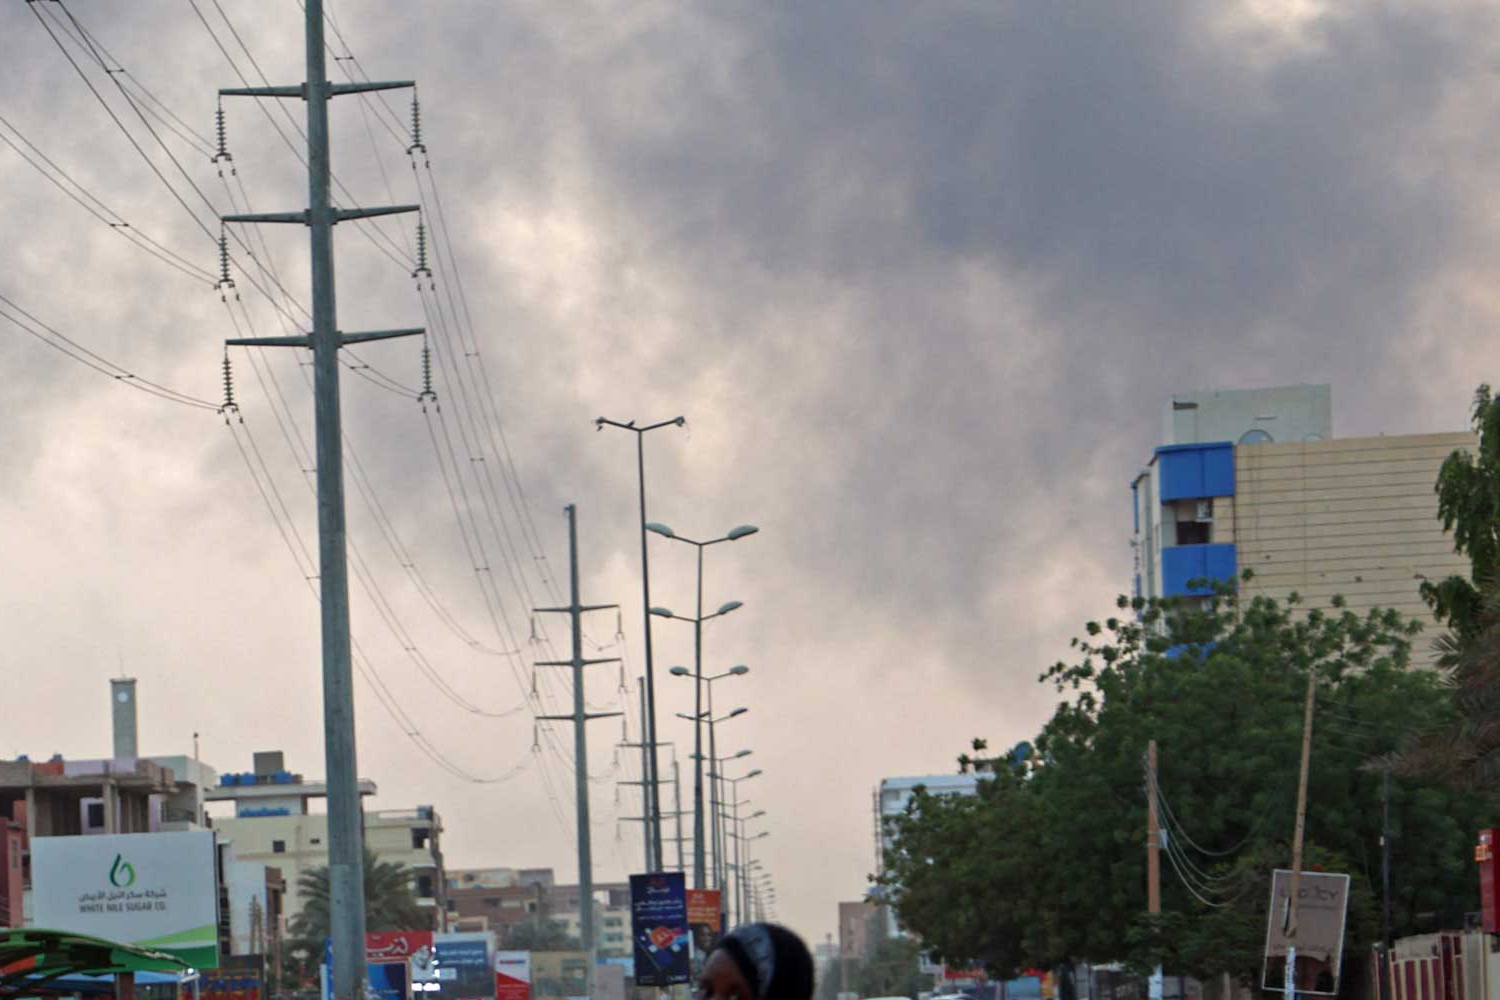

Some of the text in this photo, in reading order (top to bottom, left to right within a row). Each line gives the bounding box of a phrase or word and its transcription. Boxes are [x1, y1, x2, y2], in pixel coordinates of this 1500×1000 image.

[79, 903, 103, 913] WHITE
[106, 903, 123, 912] NILE
[126, 902, 152, 911] SUGAR
